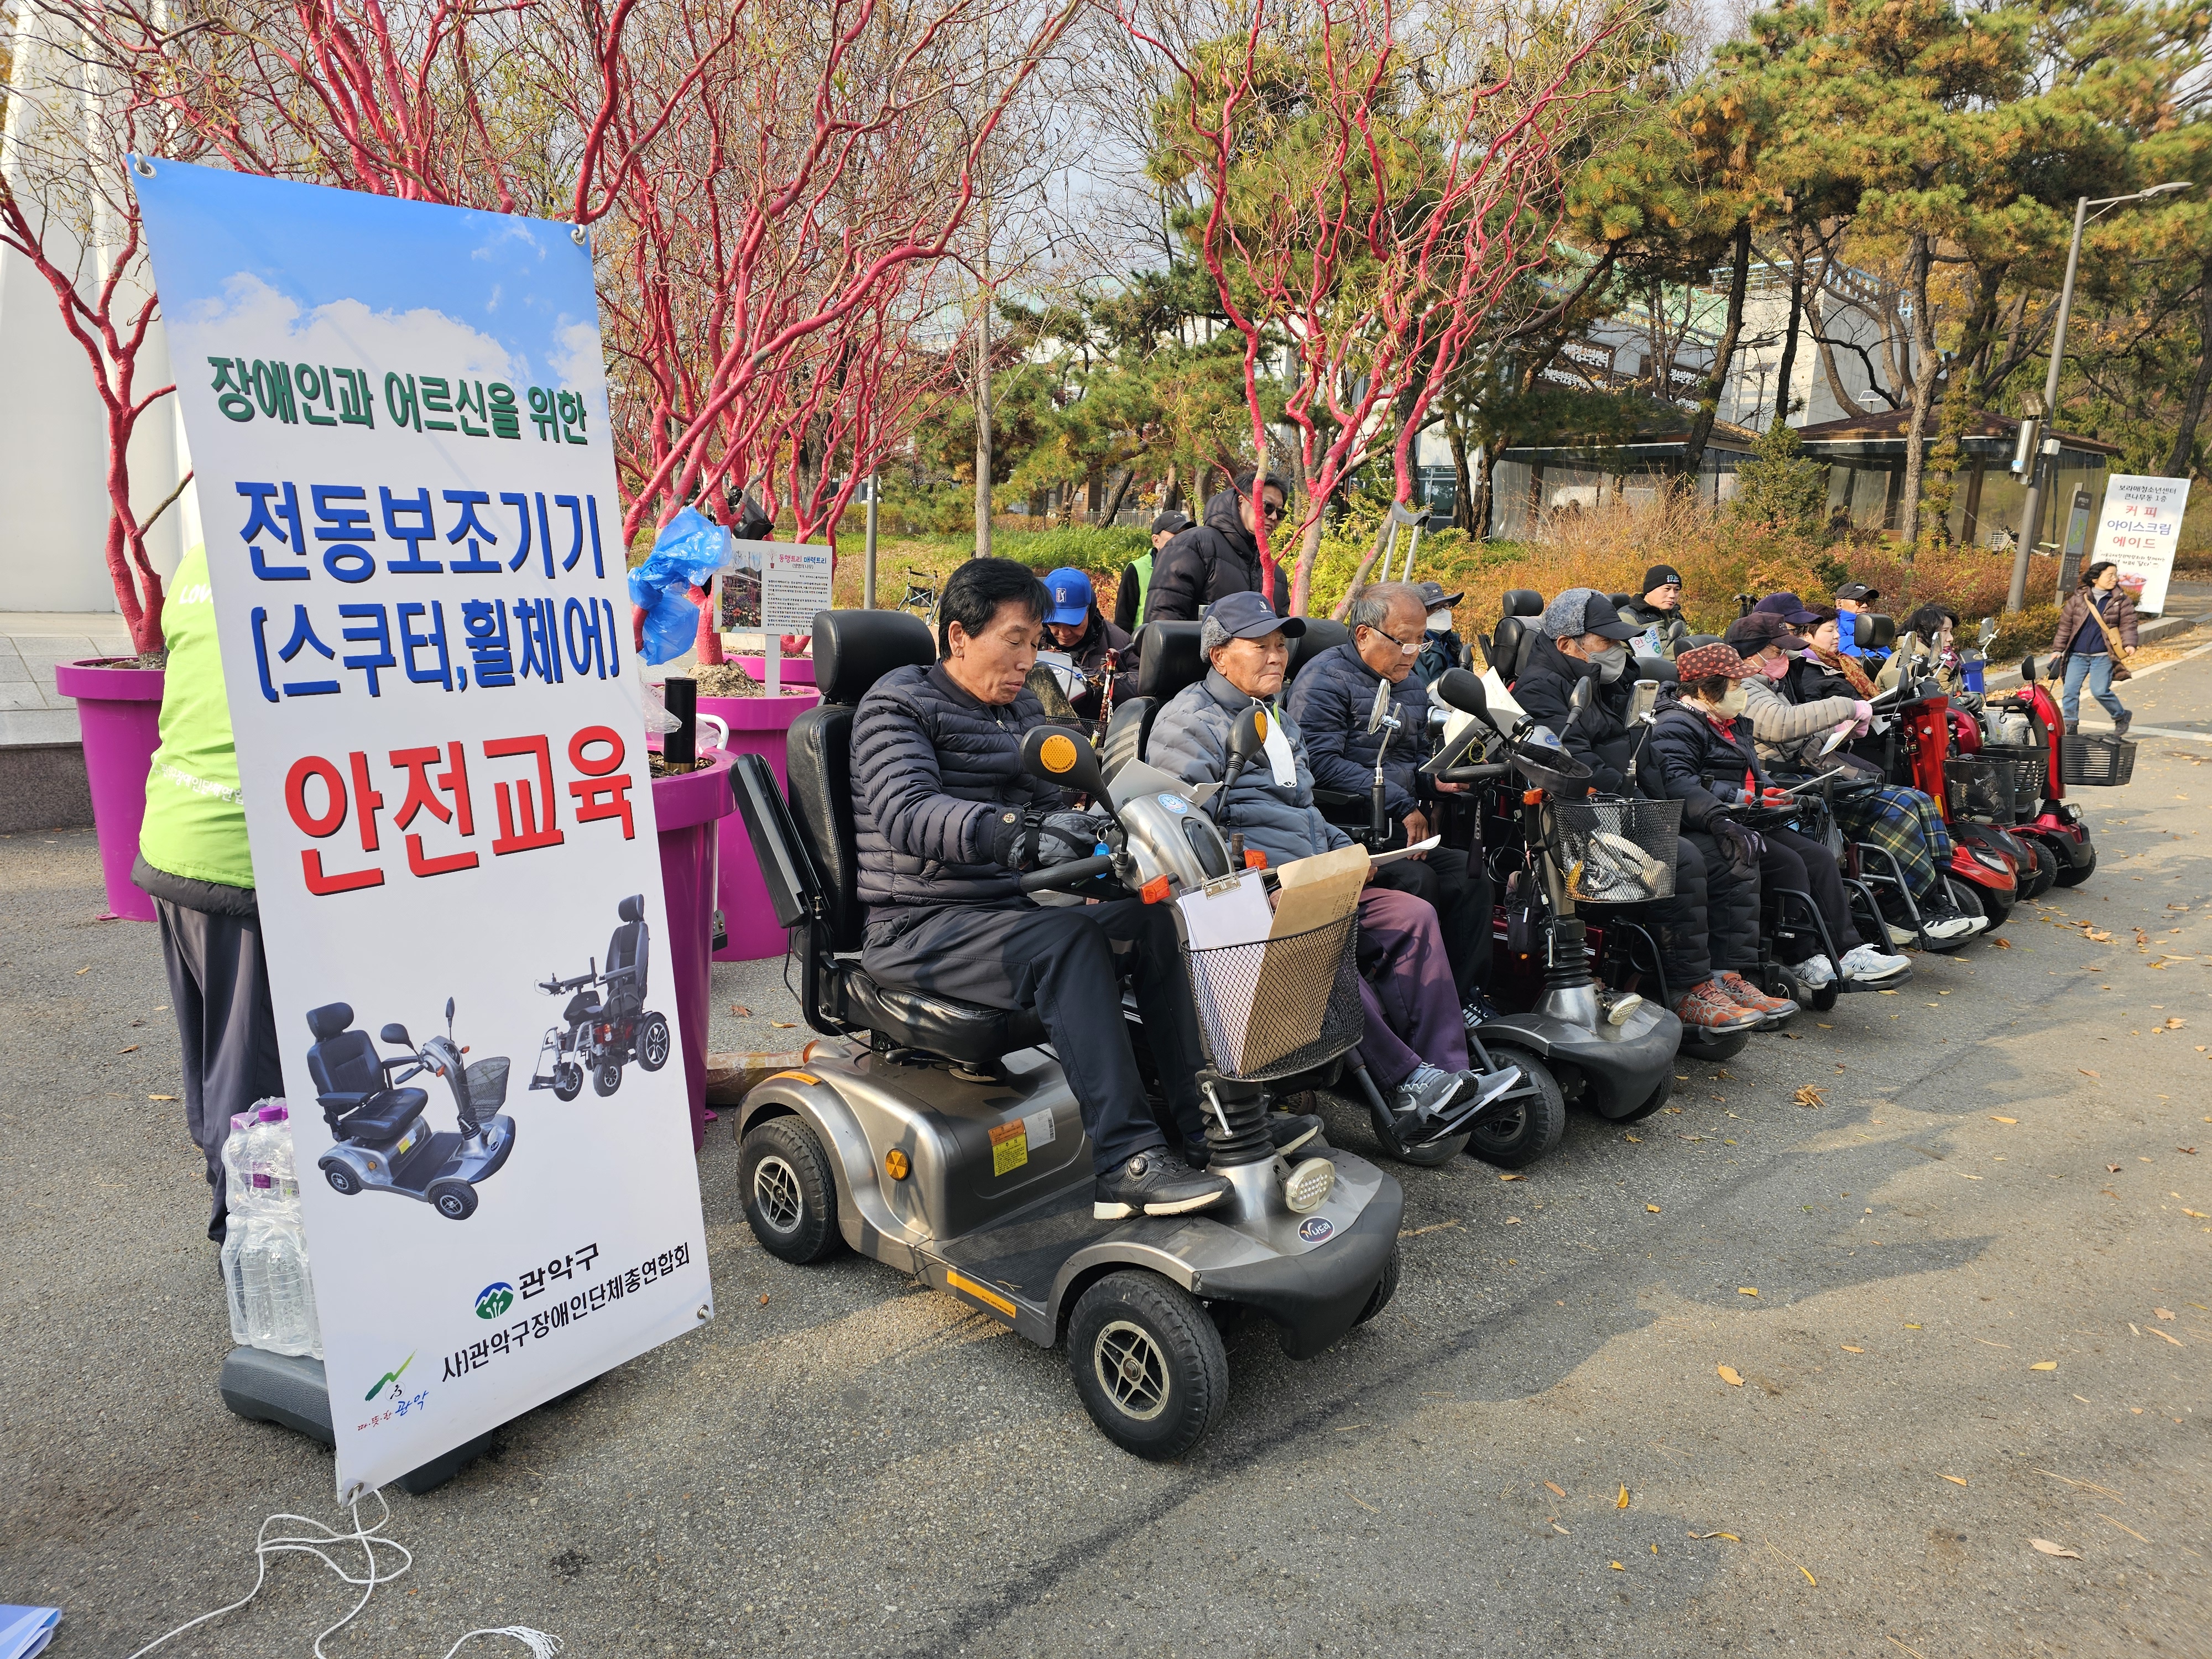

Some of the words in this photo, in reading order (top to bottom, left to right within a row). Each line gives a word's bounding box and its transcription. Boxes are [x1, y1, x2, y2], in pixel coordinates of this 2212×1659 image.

[207, 356, 373, 429] 장애인과
[385, 371, 520, 440] 어르신을
[529, 385, 587, 445] 위한
[2119, 485, 2177, 494] 보라매청소년센터
[235, 481, 605, 583] 전동보조기기
[2107, 520, 2172, 535] 아이스크림
[779, 554, 802, 563] 동행트리
[804, 556, 827, 565] 매력트리
[251, 597, 620, 703] (스쿠터,휠체어)
[284, 725, 635, 896] 안전교육
[519, 1243, 599, 1298] 관악구
[395, 1390, 430, 1416] 관악
